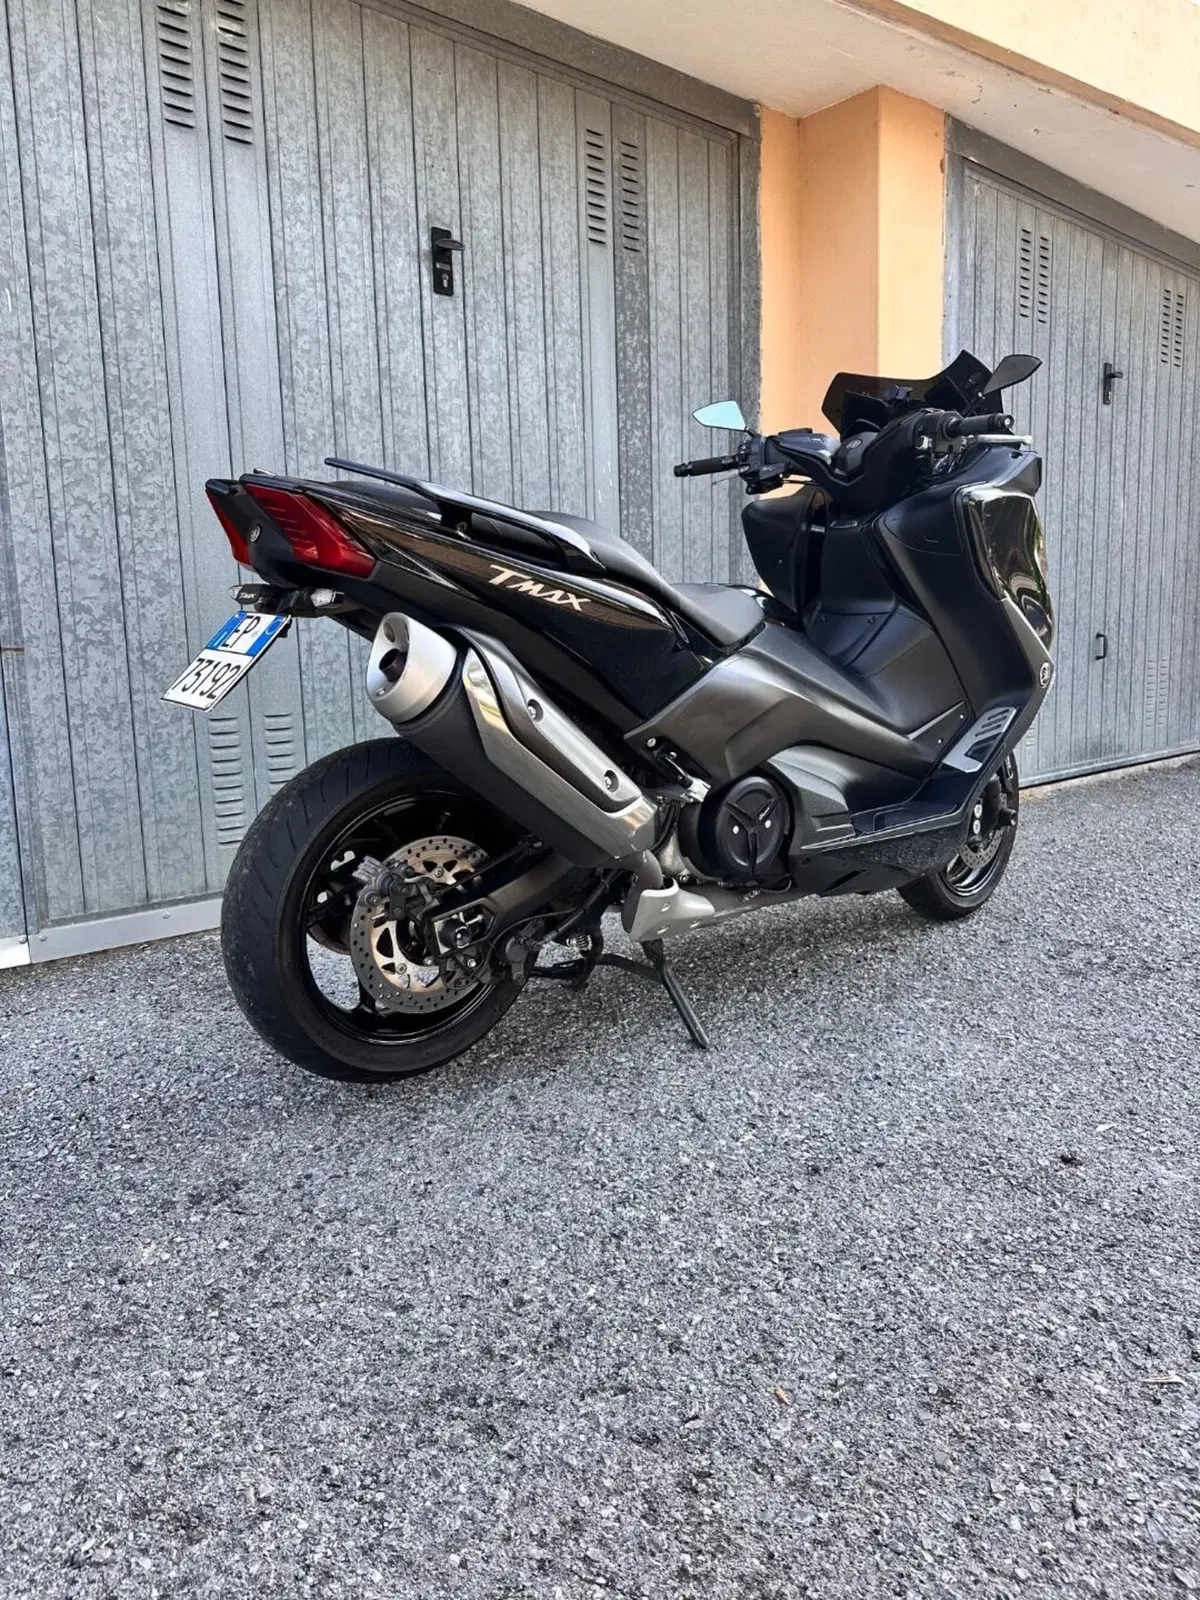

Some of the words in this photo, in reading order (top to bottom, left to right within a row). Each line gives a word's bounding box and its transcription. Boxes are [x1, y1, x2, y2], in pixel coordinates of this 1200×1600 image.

[488, 564, 592, 611] TMAX
[221, 615, 261, 648] EP
[171, 658, 241, 699] 73192
